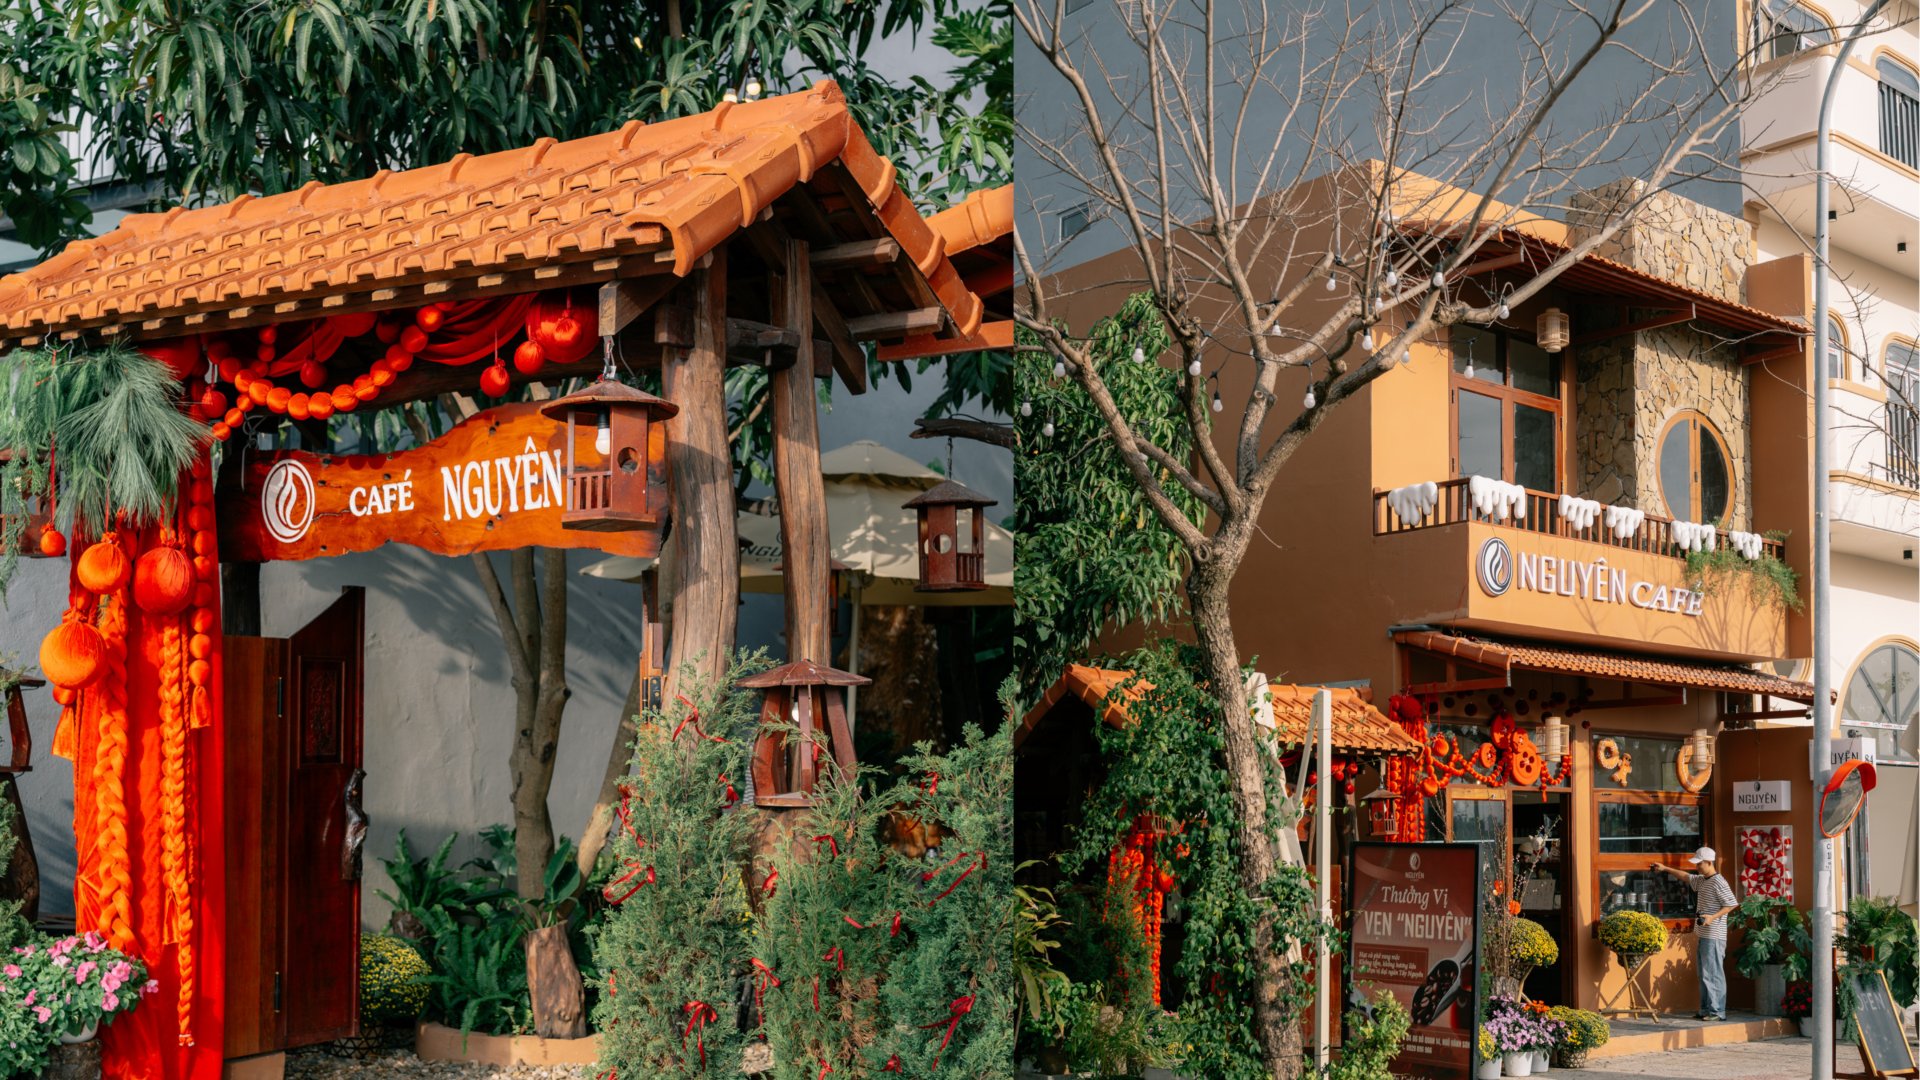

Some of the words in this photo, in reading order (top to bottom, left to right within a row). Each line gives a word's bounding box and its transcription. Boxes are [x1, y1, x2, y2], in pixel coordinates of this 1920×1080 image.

[350, 469, 414, 517] CAFÉ
[441, 436, 563, 521] NGUYÊN
[1517, 552, 1626, 604] NGUYÊN
[1738, 792, 1777, 804] NGUYÊN
[1381, 885, 1430, 910] Thưởng
[1433, 888, 1448, 908] Vị
[1364, 911, 1392, 940] VẸN
